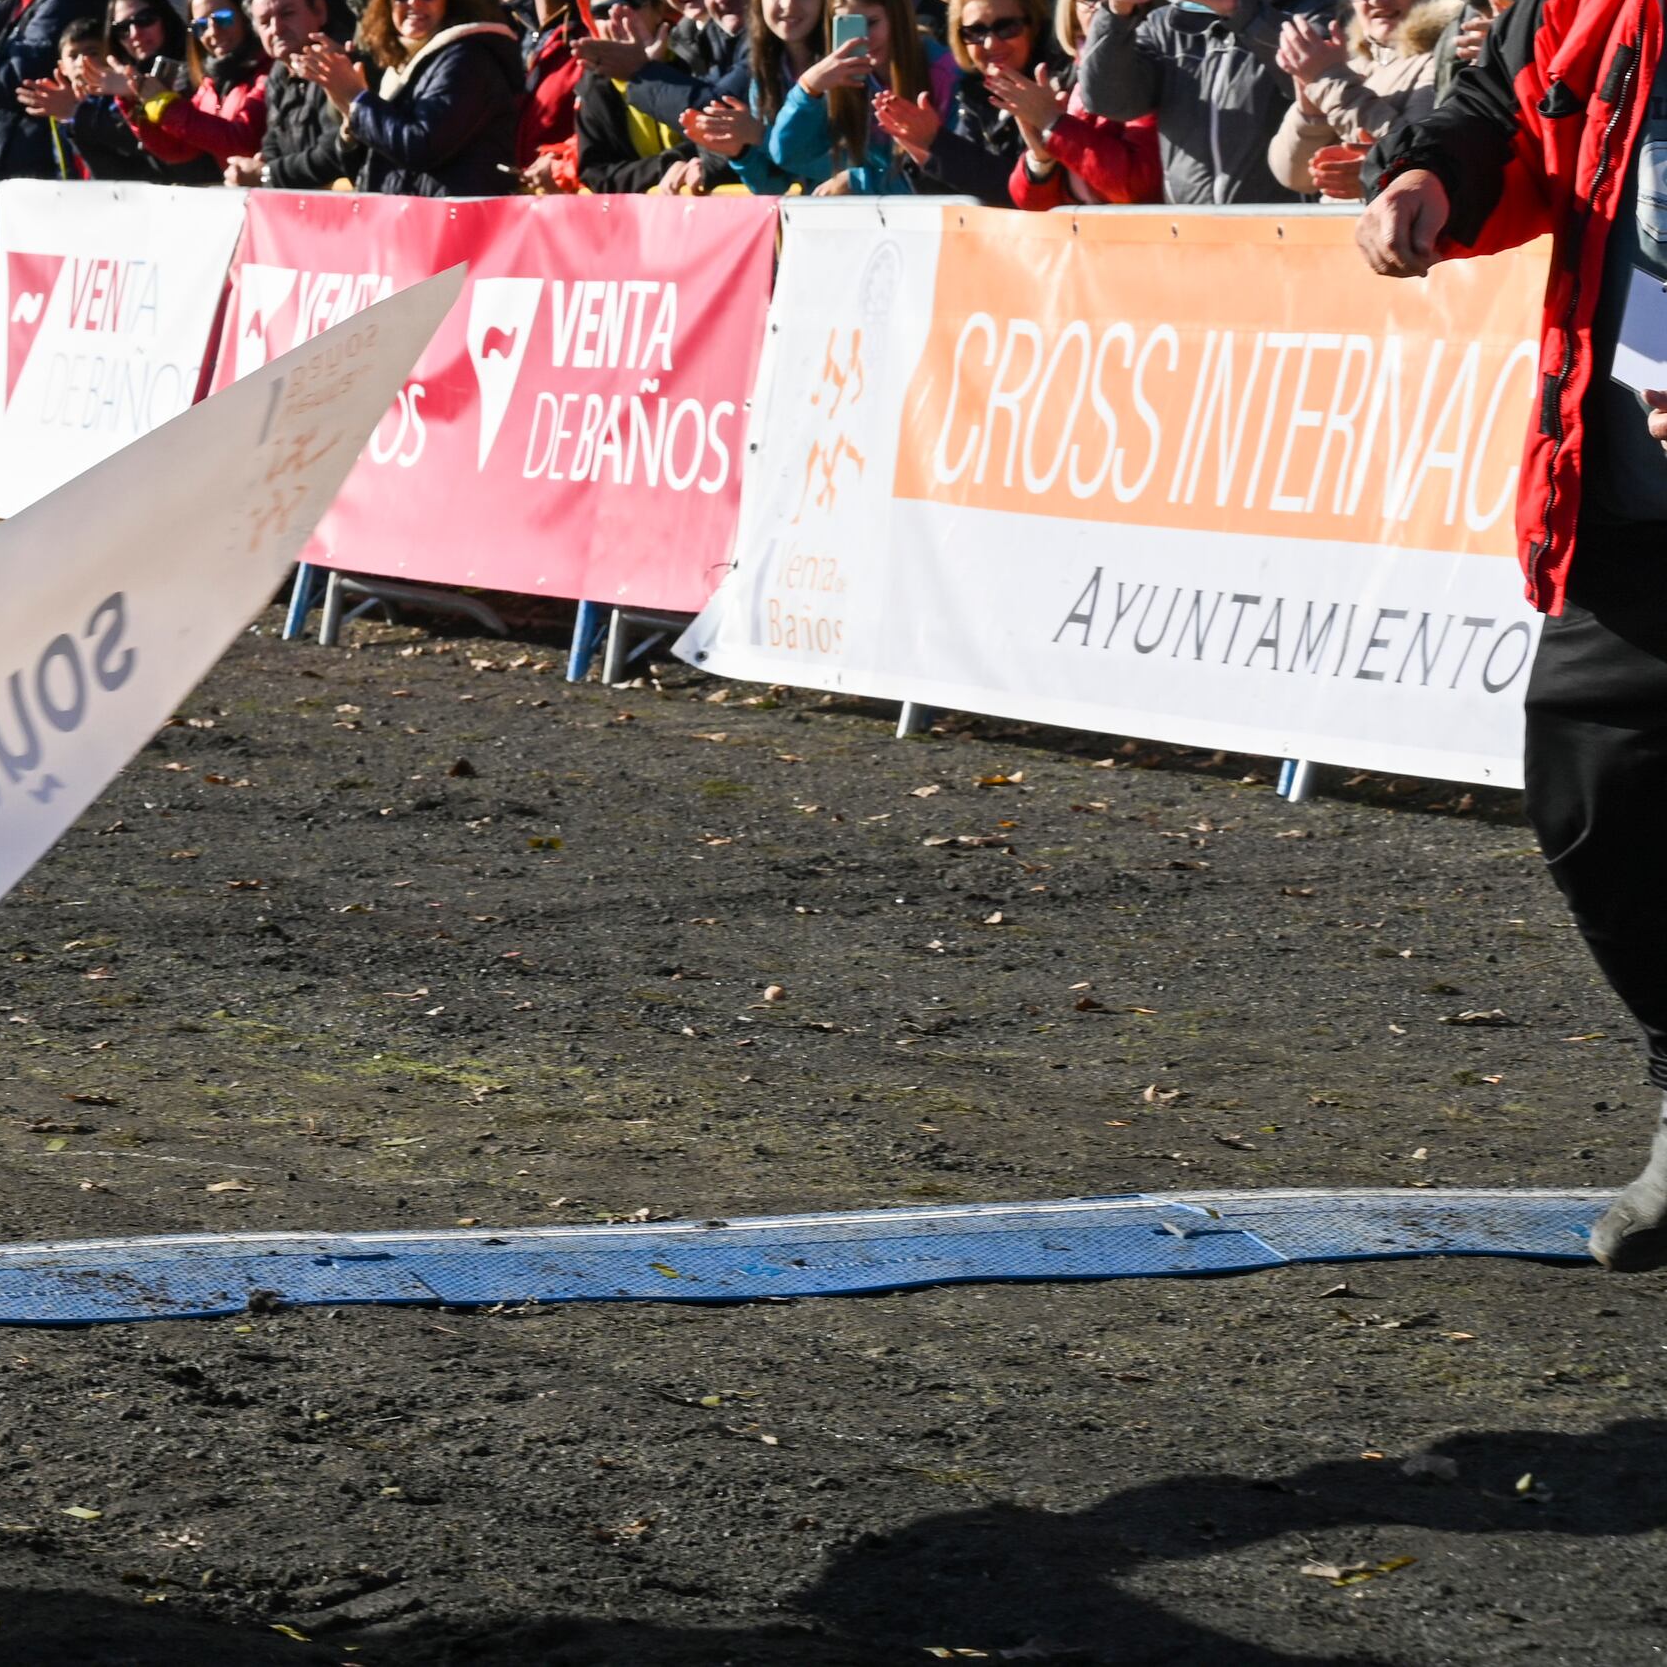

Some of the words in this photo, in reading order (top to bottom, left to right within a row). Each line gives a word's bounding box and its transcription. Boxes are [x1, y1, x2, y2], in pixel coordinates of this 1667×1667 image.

[70, 259, 158, 336] VENTA
[552, 280, 677, 371] VENTA
[933, 312, 1179, 503] CROSS
[1168, 330, 1539, 532] INTERNAC
[1052, 565, 1533, 694] AYUNTAMIENTO
